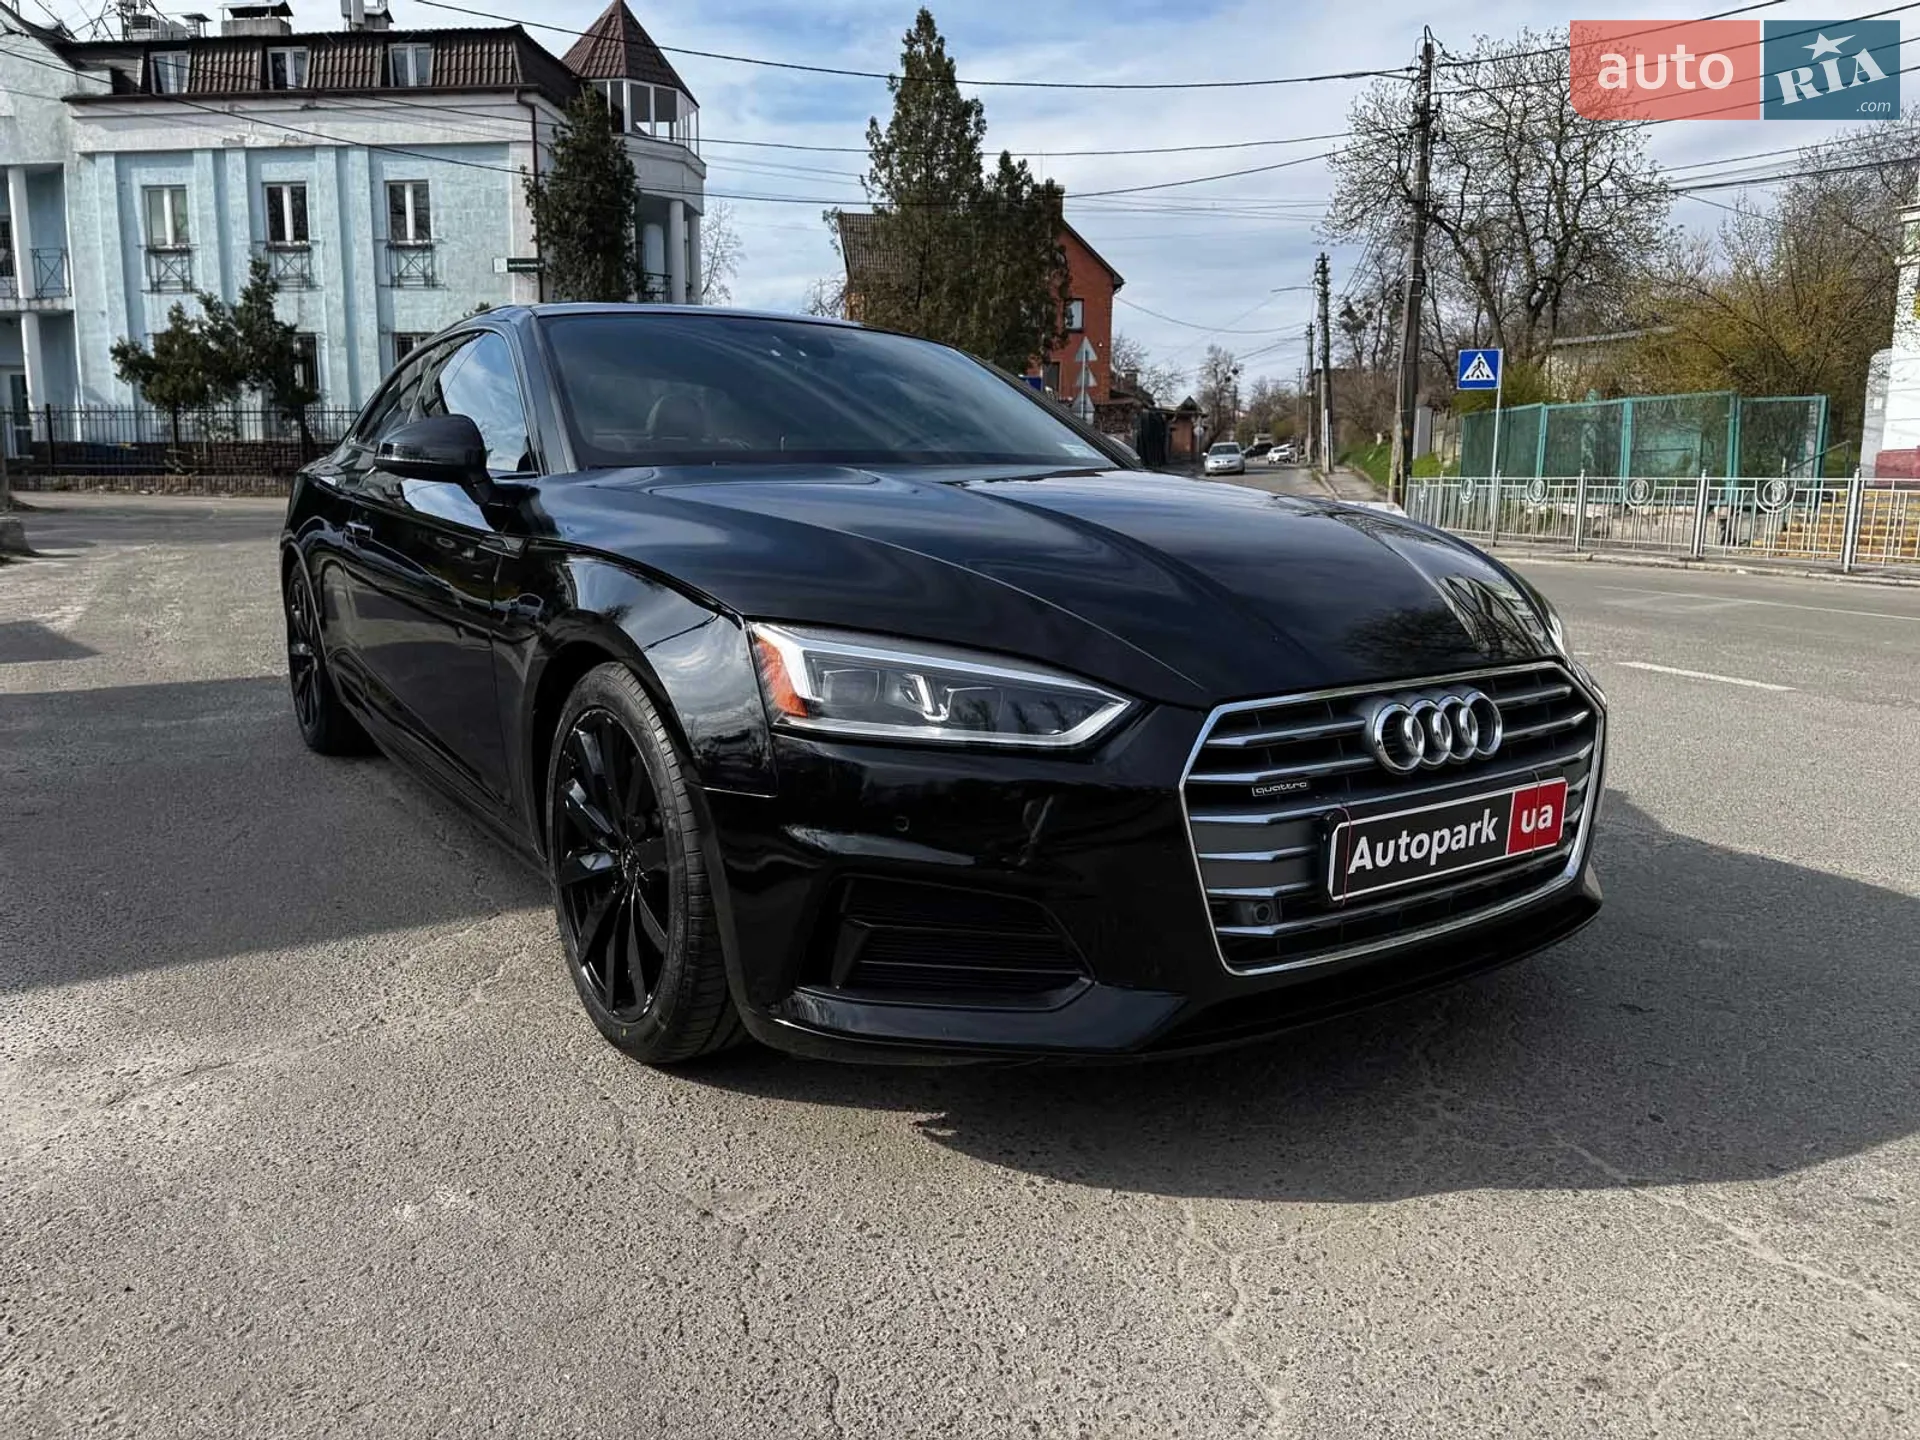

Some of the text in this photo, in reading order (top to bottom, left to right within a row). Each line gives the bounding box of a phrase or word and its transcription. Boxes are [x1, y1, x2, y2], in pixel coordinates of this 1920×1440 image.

[1255, 781, 1307, 795] quattro
[1348, 803, 1553, 874] Autopark ua
